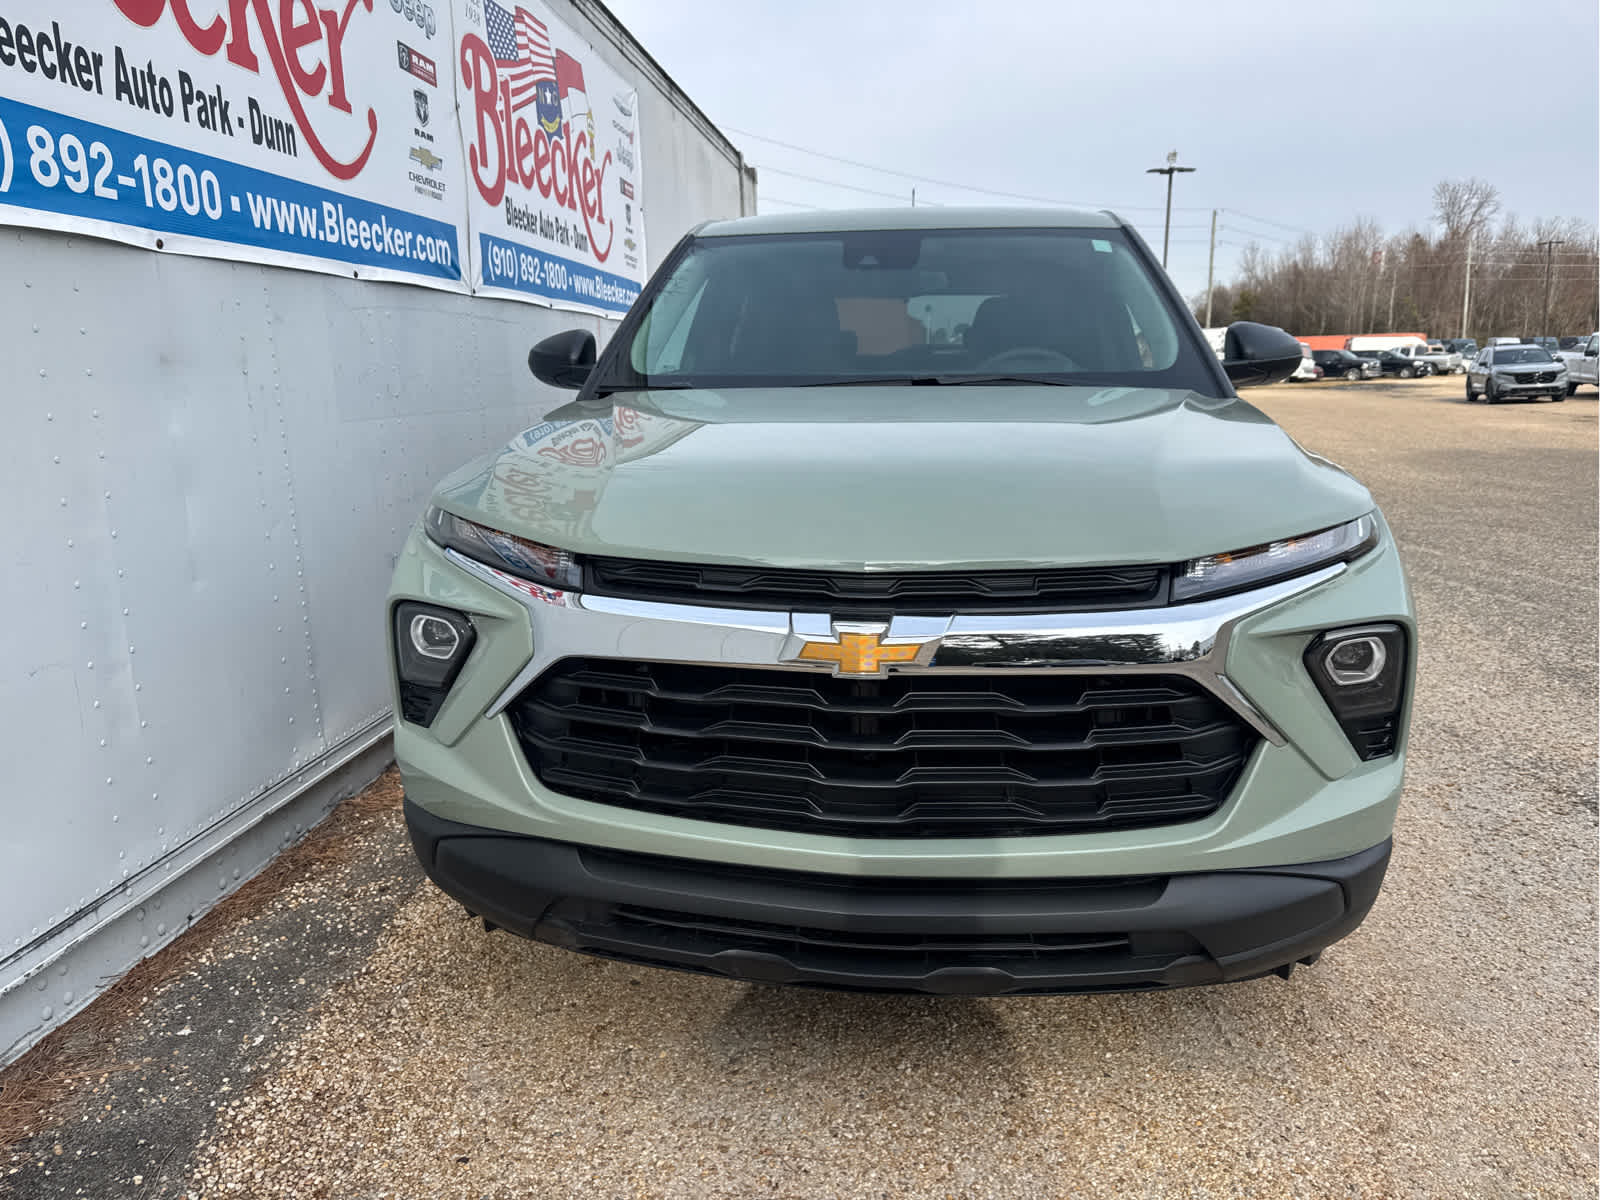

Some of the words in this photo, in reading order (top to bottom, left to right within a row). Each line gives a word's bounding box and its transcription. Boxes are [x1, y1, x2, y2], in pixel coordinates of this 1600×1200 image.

[411, 54, 434, 74] RAM
[115, 45, 174, 118] Auto
[178, 69, 234, 137] Park
[248, 96, 298, 157] Dunn
[414, 127, 435, 143] RAM
[460, 32, 613, 262] Bleecker
[27, 124, 223, 220] 892-1800
[246, 191, 452, 266] www.Bleecker.com
[408, 171, 446, 192] CHEVROLET
[505, 195, 538, 234] Bleecker
[539, 209, 555, 241] Auto
[555, 216, 570, 246] Park
[574, 224, 588, 252] Dunn
[488, 240, 519, 285] (910)
[520, 253, 568, 290] 892-1800
